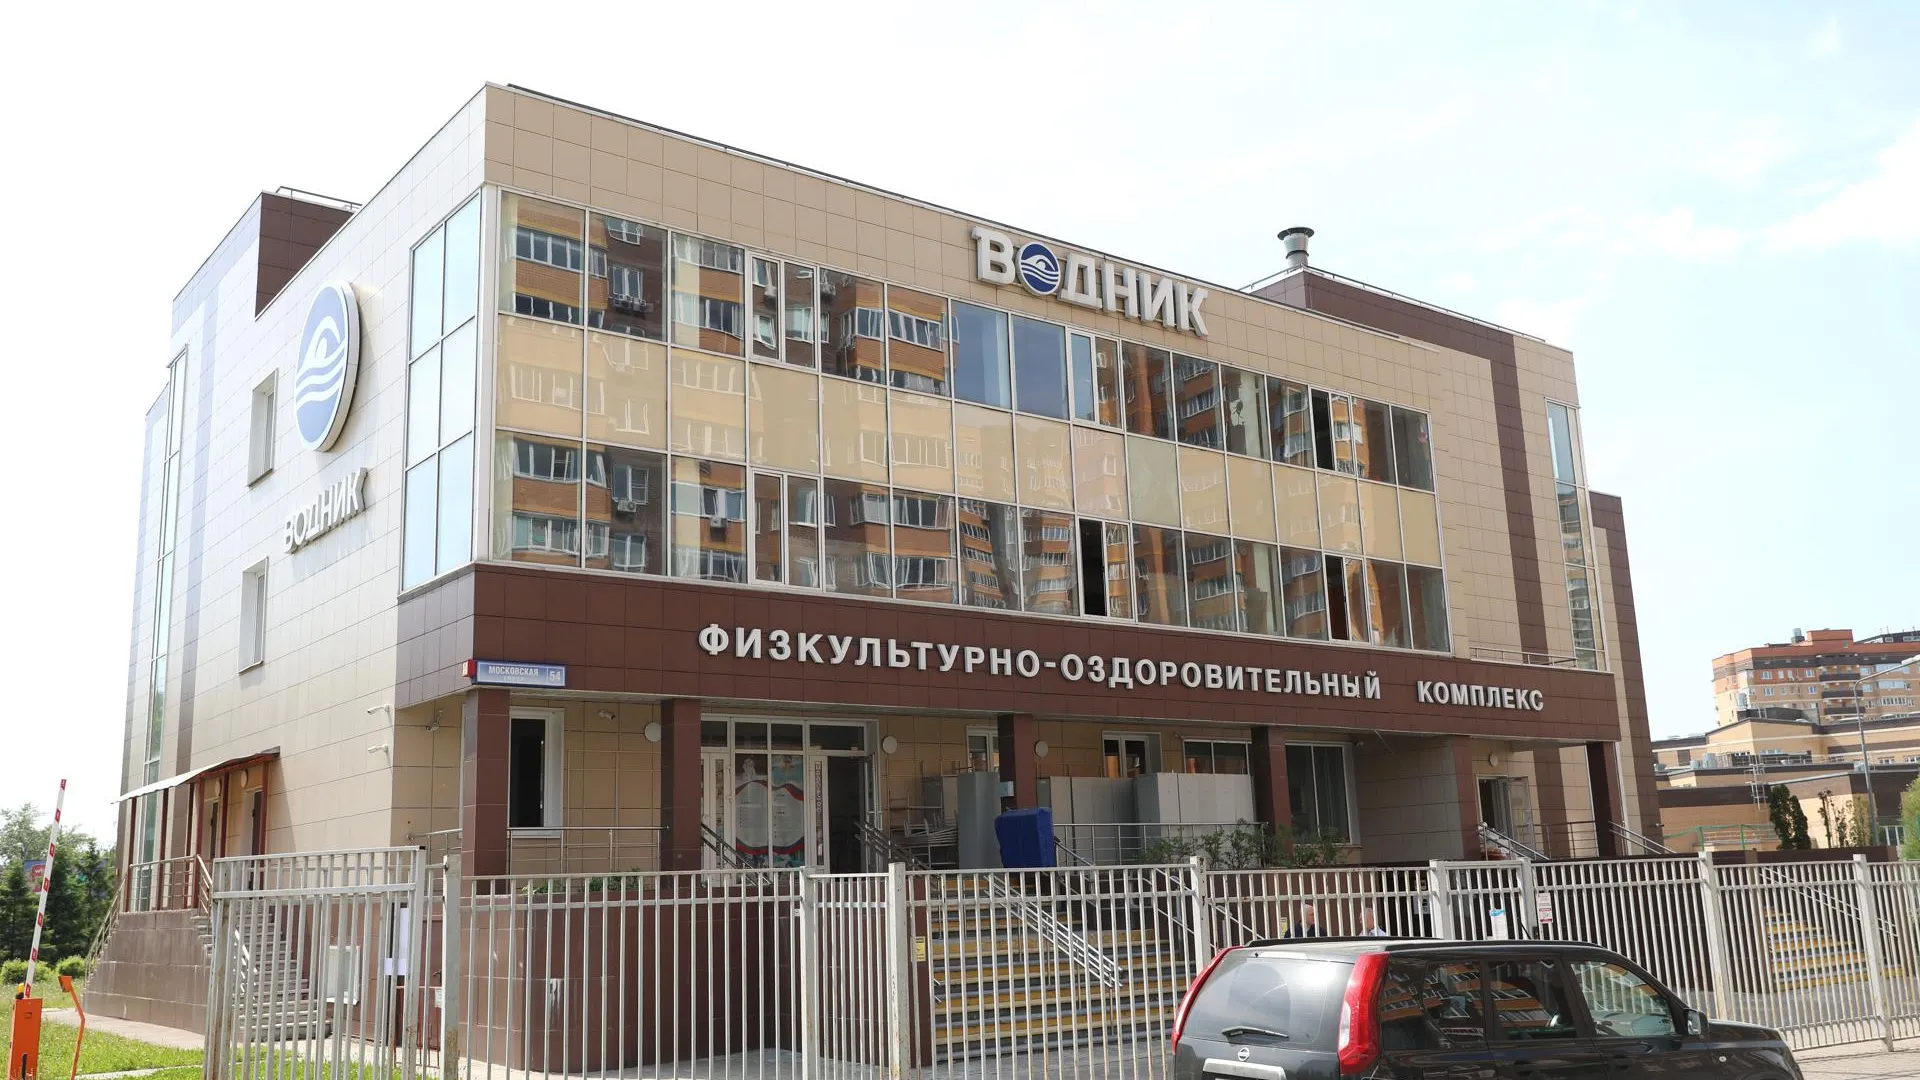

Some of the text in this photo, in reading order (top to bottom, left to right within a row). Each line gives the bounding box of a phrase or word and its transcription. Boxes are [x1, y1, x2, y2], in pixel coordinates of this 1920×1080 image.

[971, 225, 1209, 337] ВОДНИК
[283, 467, 368, 554] ВОДНИК
[488, 665, 561, 682] МОСКОВСКАЯ 54
[698, 623, 1544, 711] ФИЗКУЛЬТУРНО-ОЗДОРОВИТЕЛЬНЫЙ КОМПЛЕКС
